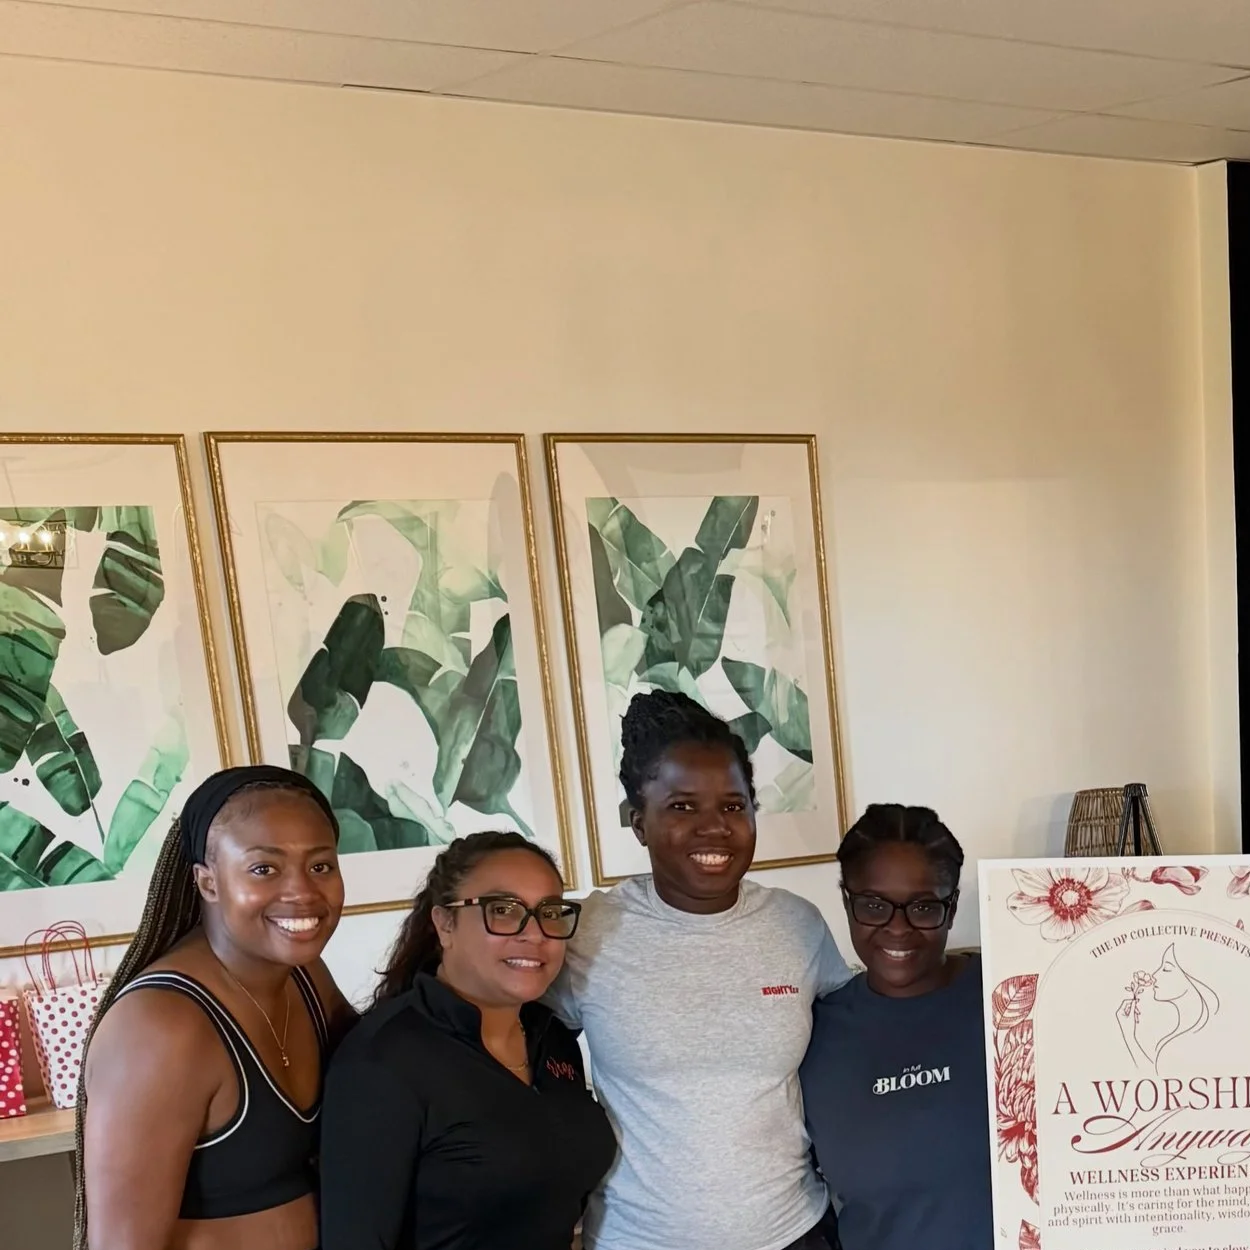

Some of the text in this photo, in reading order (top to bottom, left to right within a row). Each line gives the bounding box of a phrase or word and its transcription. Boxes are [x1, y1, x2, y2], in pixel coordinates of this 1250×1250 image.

[1090, 941, 1113, 959] THE
[1113, 934, 1128, 947] DP
[1130, 925, 1197, 941] COLLECTIVE
[872, 1066, 951, 1095] BLOOM
[1052, 1082, 1078, 1115] A
[1070, 1167, 1160, 1185] WELLNESS
[1064, 1190, 1116, 1201] Wellness
[1119, 1189, 1128, 1199] is
[1131, 1190, 1161, 1199] more
[1163, 1186, 1190, 1197] than
[1193, 1185, 1221, 1196] what
[1053, 1202, 1114, 1217] physically.
[1138, 1200, 1174, 1213] caring
[1177, 1199, 1193, 1209] for
[1196, 1197, 1215, 1208] the
[1217, 1196, 1250, 1207] mind,
[1048, 1216, 1069, 1227] and
[1072, 1215, 1104, 1228] spirit
[1106, 1213, 1131, 1224] with
[1134, 1210, 1215, 1222] intentionality,
